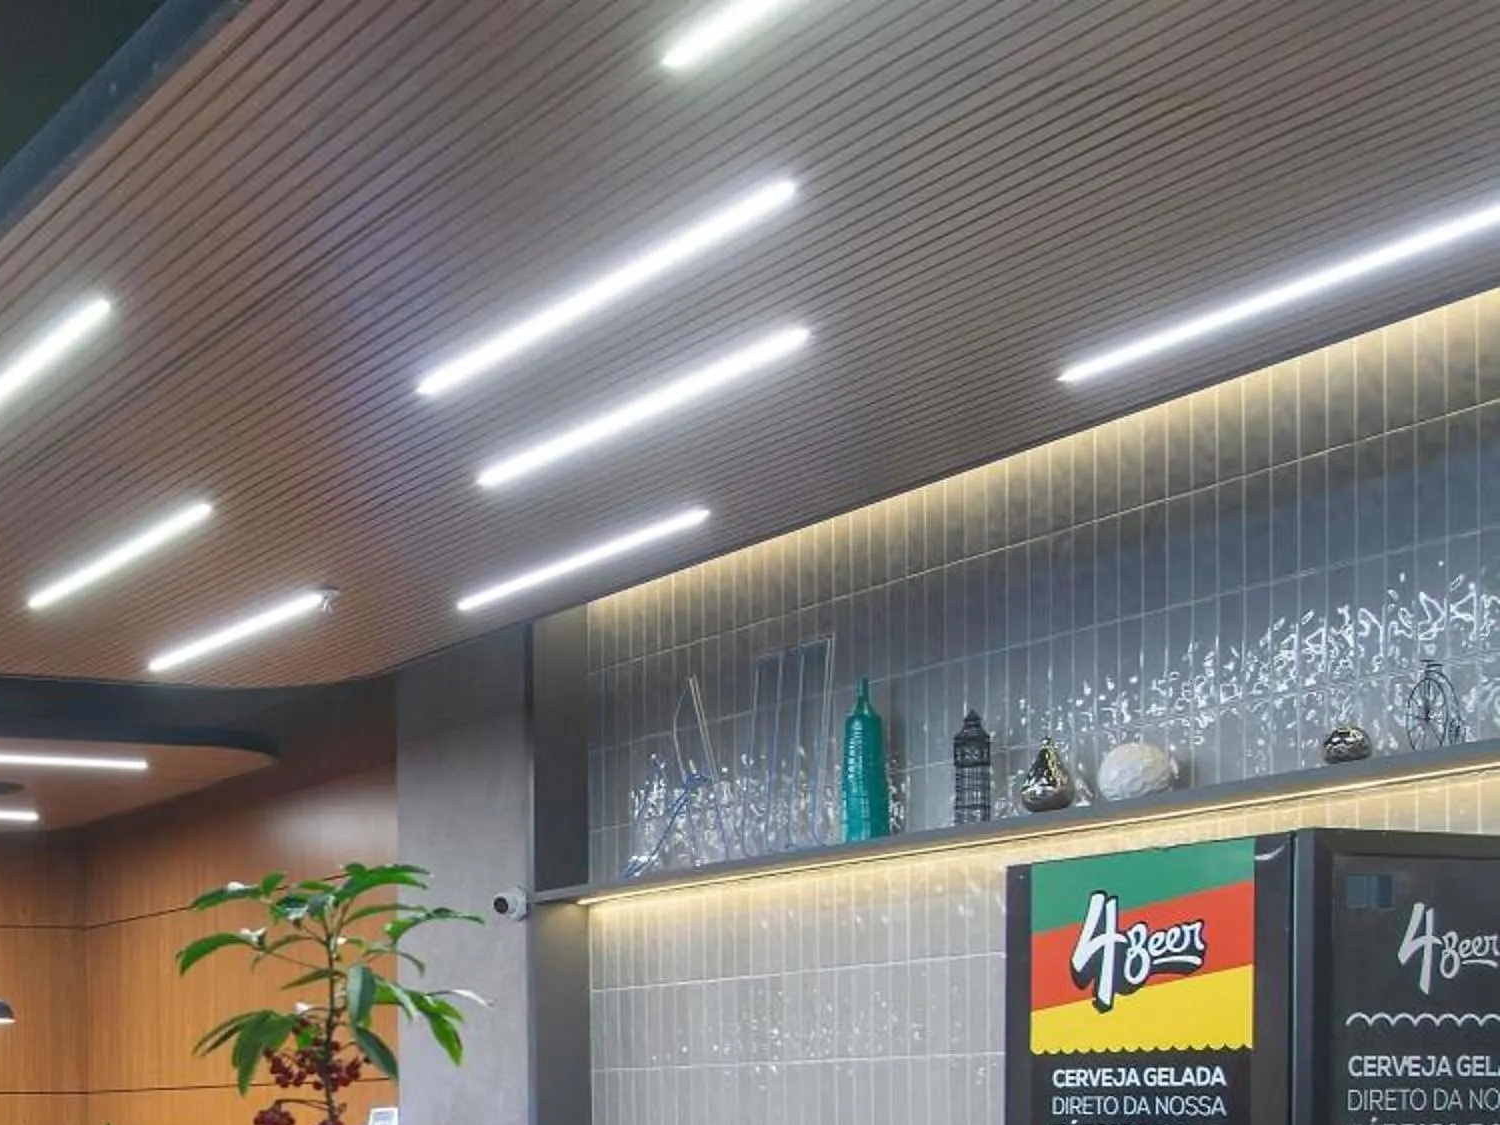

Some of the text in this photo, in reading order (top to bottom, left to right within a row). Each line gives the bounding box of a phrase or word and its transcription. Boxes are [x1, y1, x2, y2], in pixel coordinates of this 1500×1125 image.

[1052, 1066, 1227, 1088] CERVEJA GELADA
[1348, 1055, 1500, 1077] CERVEJA GEL
[1052, 1096, 1227, 1117] DIRETO DA NOSSA
[1347, 1088, 1427, 1111] DIRETO
[1433, 1088, 1464, 1111] DA
